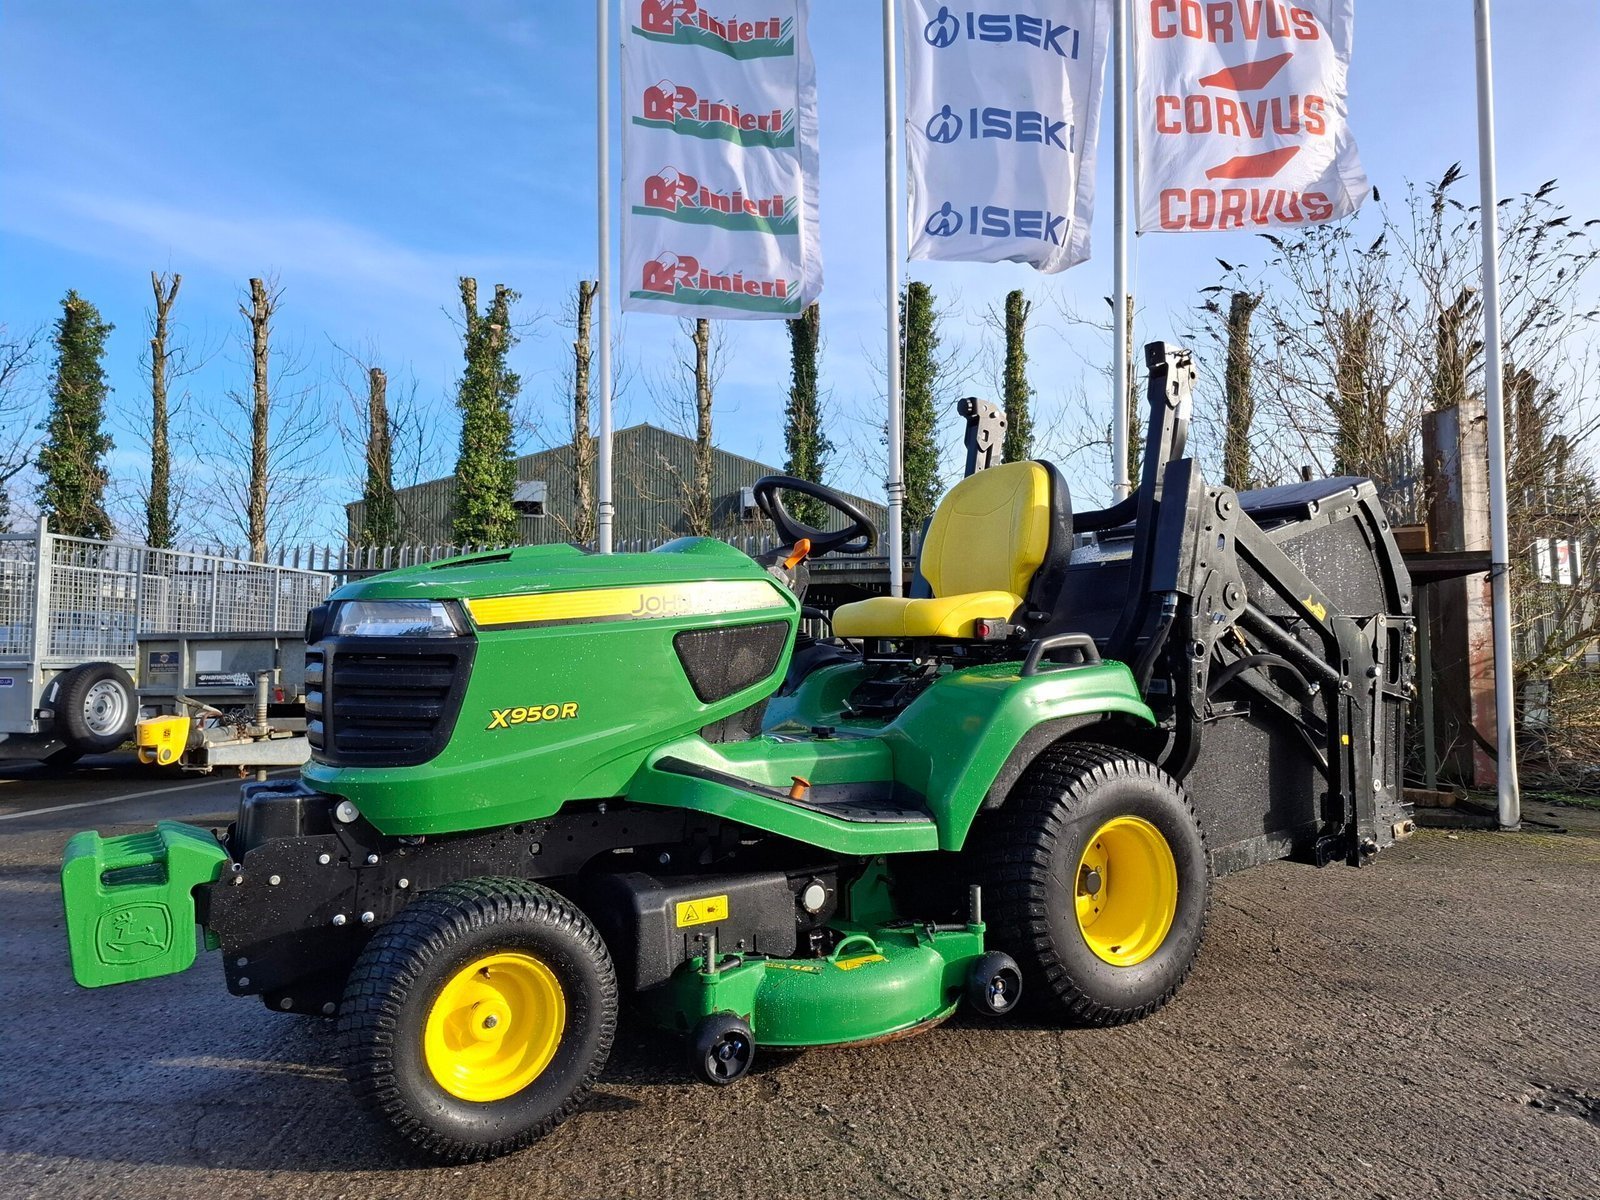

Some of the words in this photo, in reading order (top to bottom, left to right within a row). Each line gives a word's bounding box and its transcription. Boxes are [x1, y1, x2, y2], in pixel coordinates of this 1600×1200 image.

[966, 12, 1080, 60] ISEKI
[1150, 0, 1320, 43] CORVUS
[970, 107, 1075, 153] ISEKI
[1156, 94, 1326, 138] CORVUS
[969, 205, 1071, 248] ISEKI
[1160, 188, 1334, 230] CORVUS
[484, 702, 579, 731] X950R
